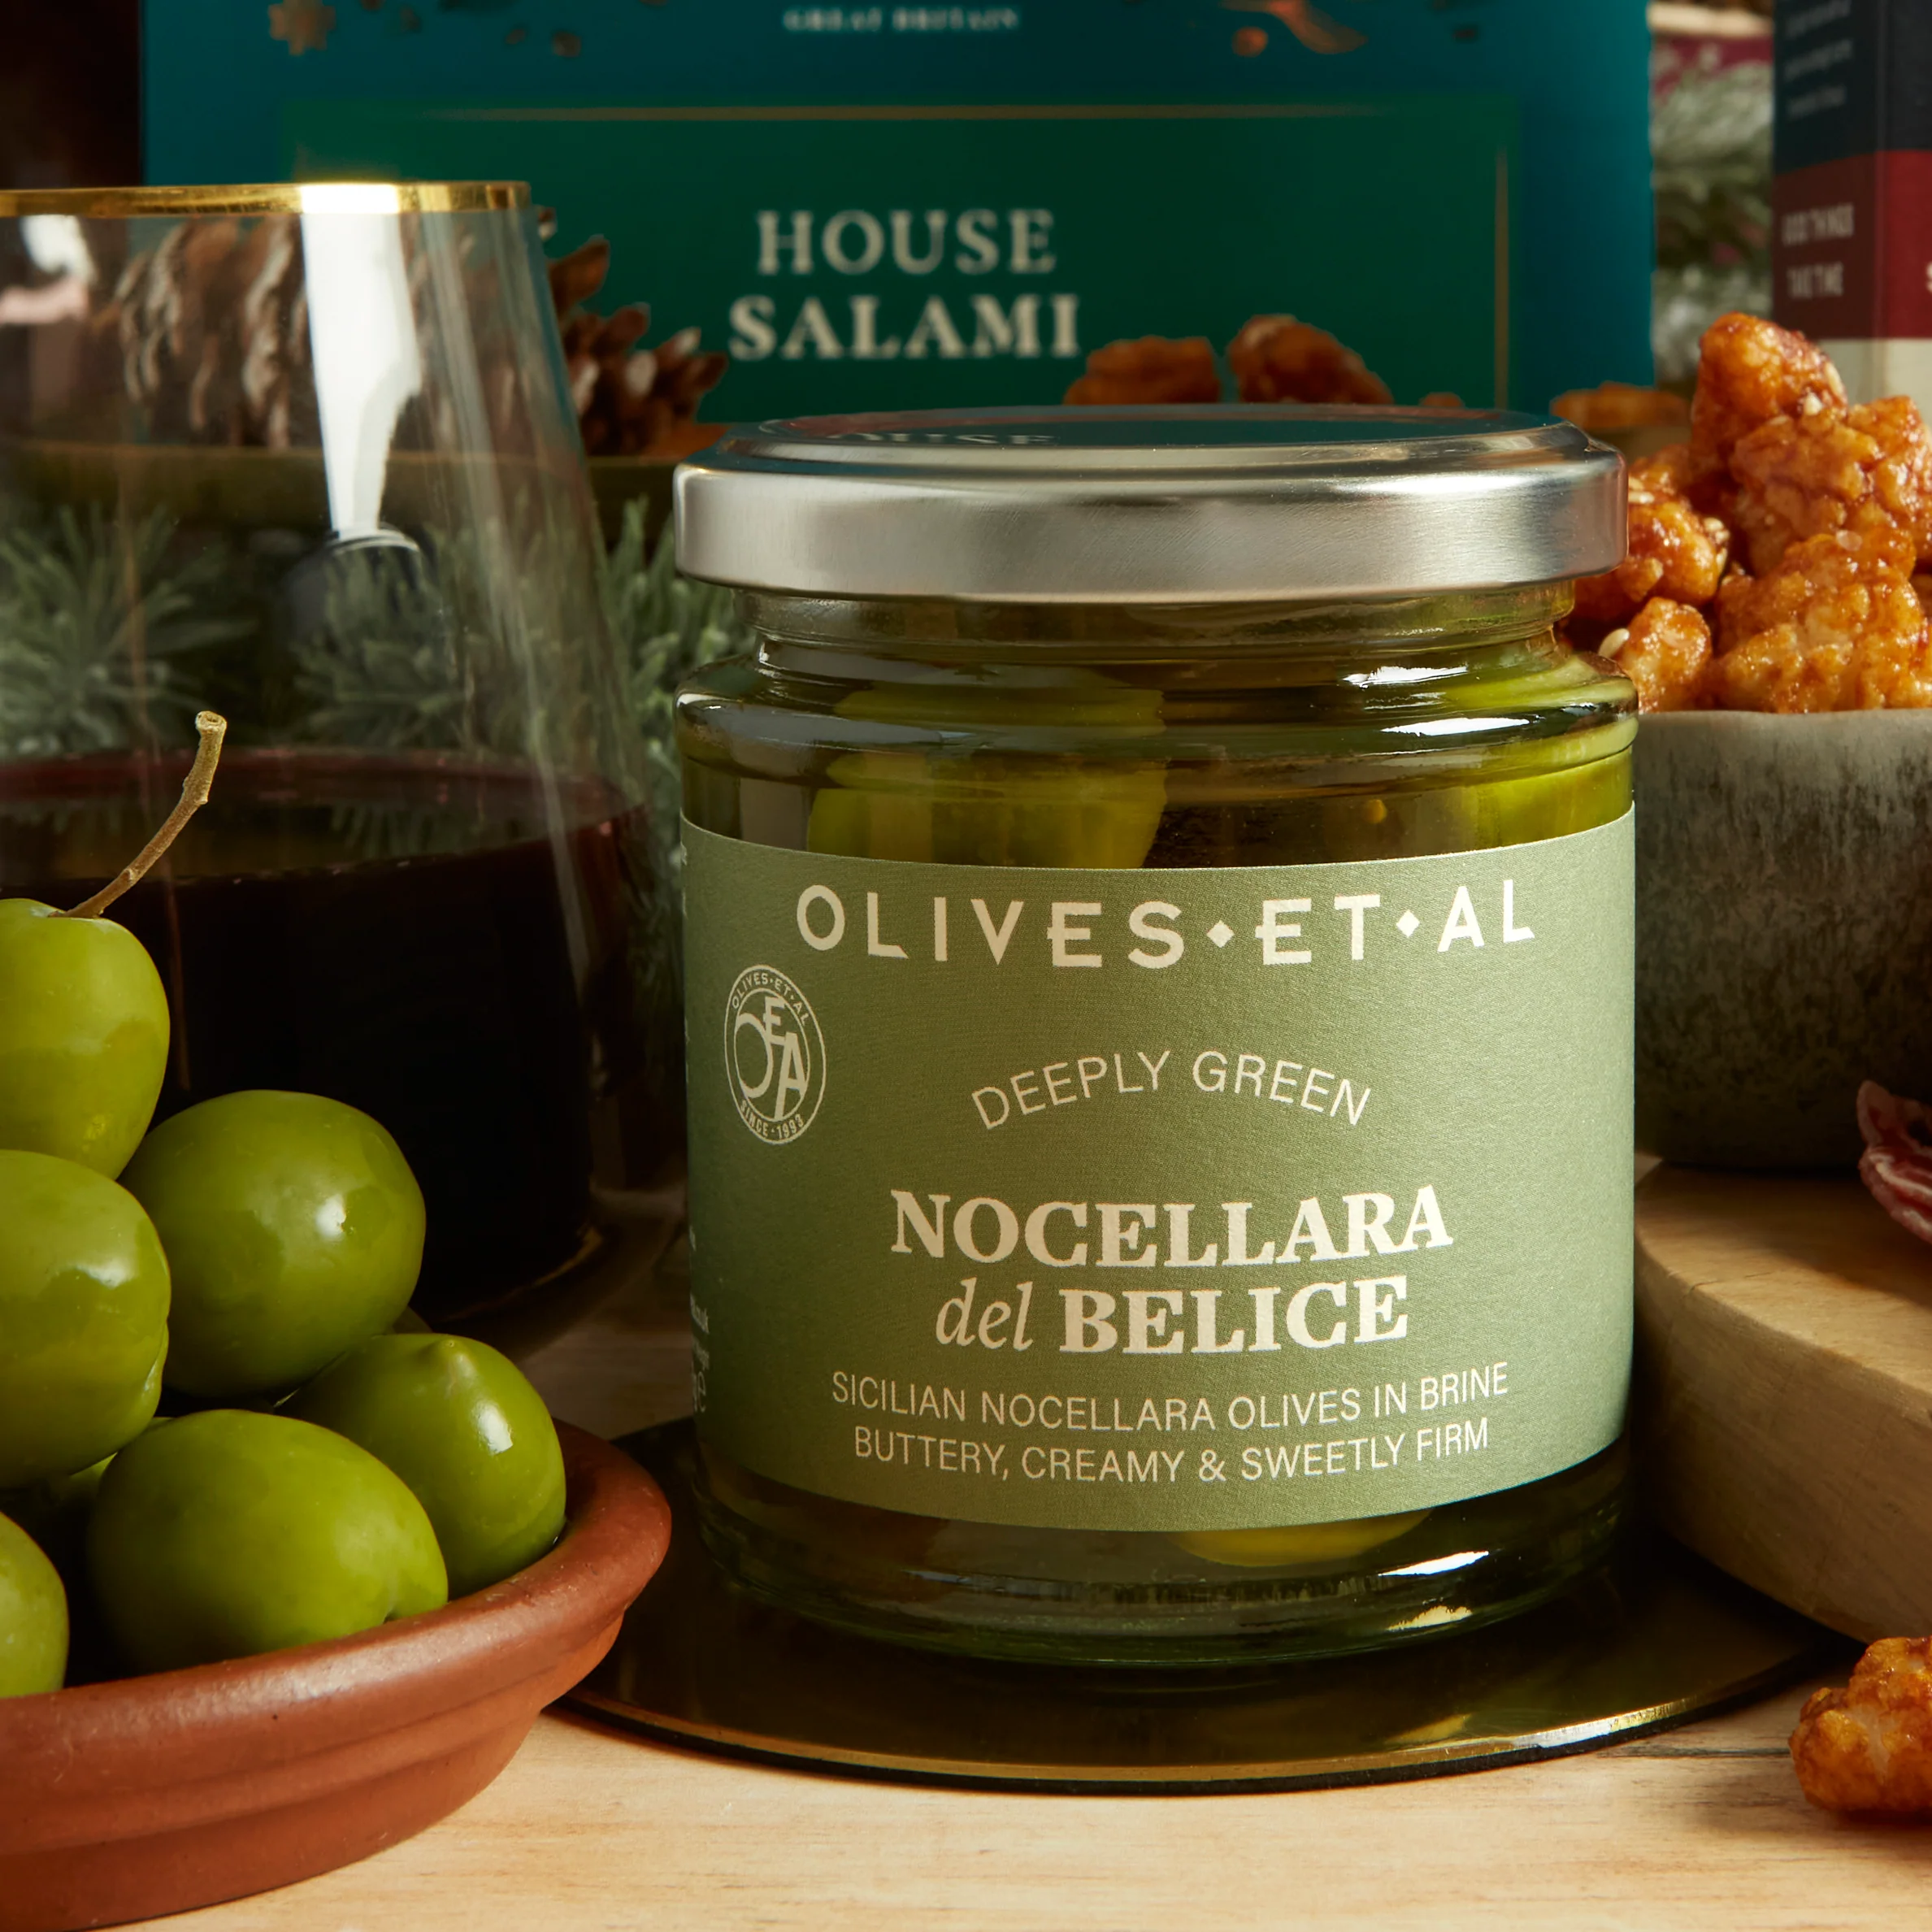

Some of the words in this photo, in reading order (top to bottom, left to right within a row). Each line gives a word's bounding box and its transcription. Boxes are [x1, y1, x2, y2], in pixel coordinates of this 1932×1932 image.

[757, 208, 1057, 275] HOUSE
[729, 293, 1079, 360] SALAMI
[797, 884, 1185, 969] OLIVES
[1255, 894, 1381, 966] ET
[1437, 879, 1535, 953] AL
[732, 973, 769, 1009] OLIVES
[740, 1100, 769, 1137] SINCE
[777, 1114, 804, 1140] 1993
[971, 1049, 1171, 1130] DEEPLY
[1192, 1051, 1372, 1127] GREEN
[890, 1183, 1454, 1268] NOCELLARA
[936, 1277, 1033, 1351] del
[1059, 1275, 1409, 1354] BELICE
[832, 1370, 966, 1422] SICILIAN
[982, 1391, 1216, 1431] NOCELLARA
[1228, 1387, 1361, 1431] OLIVES
[1374, 1382, 1407, 1418] IN
[1421, 1361, 1509, 1411] BRINE
[855, 1426, 1008, 1481] BUTTERY,
[1022, 1446, 1184, 1483] CREAMY
[1199, 1448, 1226, 1483] &
[1241, 1433, 1406, 1482] SWEETLY
[1417, 1417, 1488, 1461] FIRM
